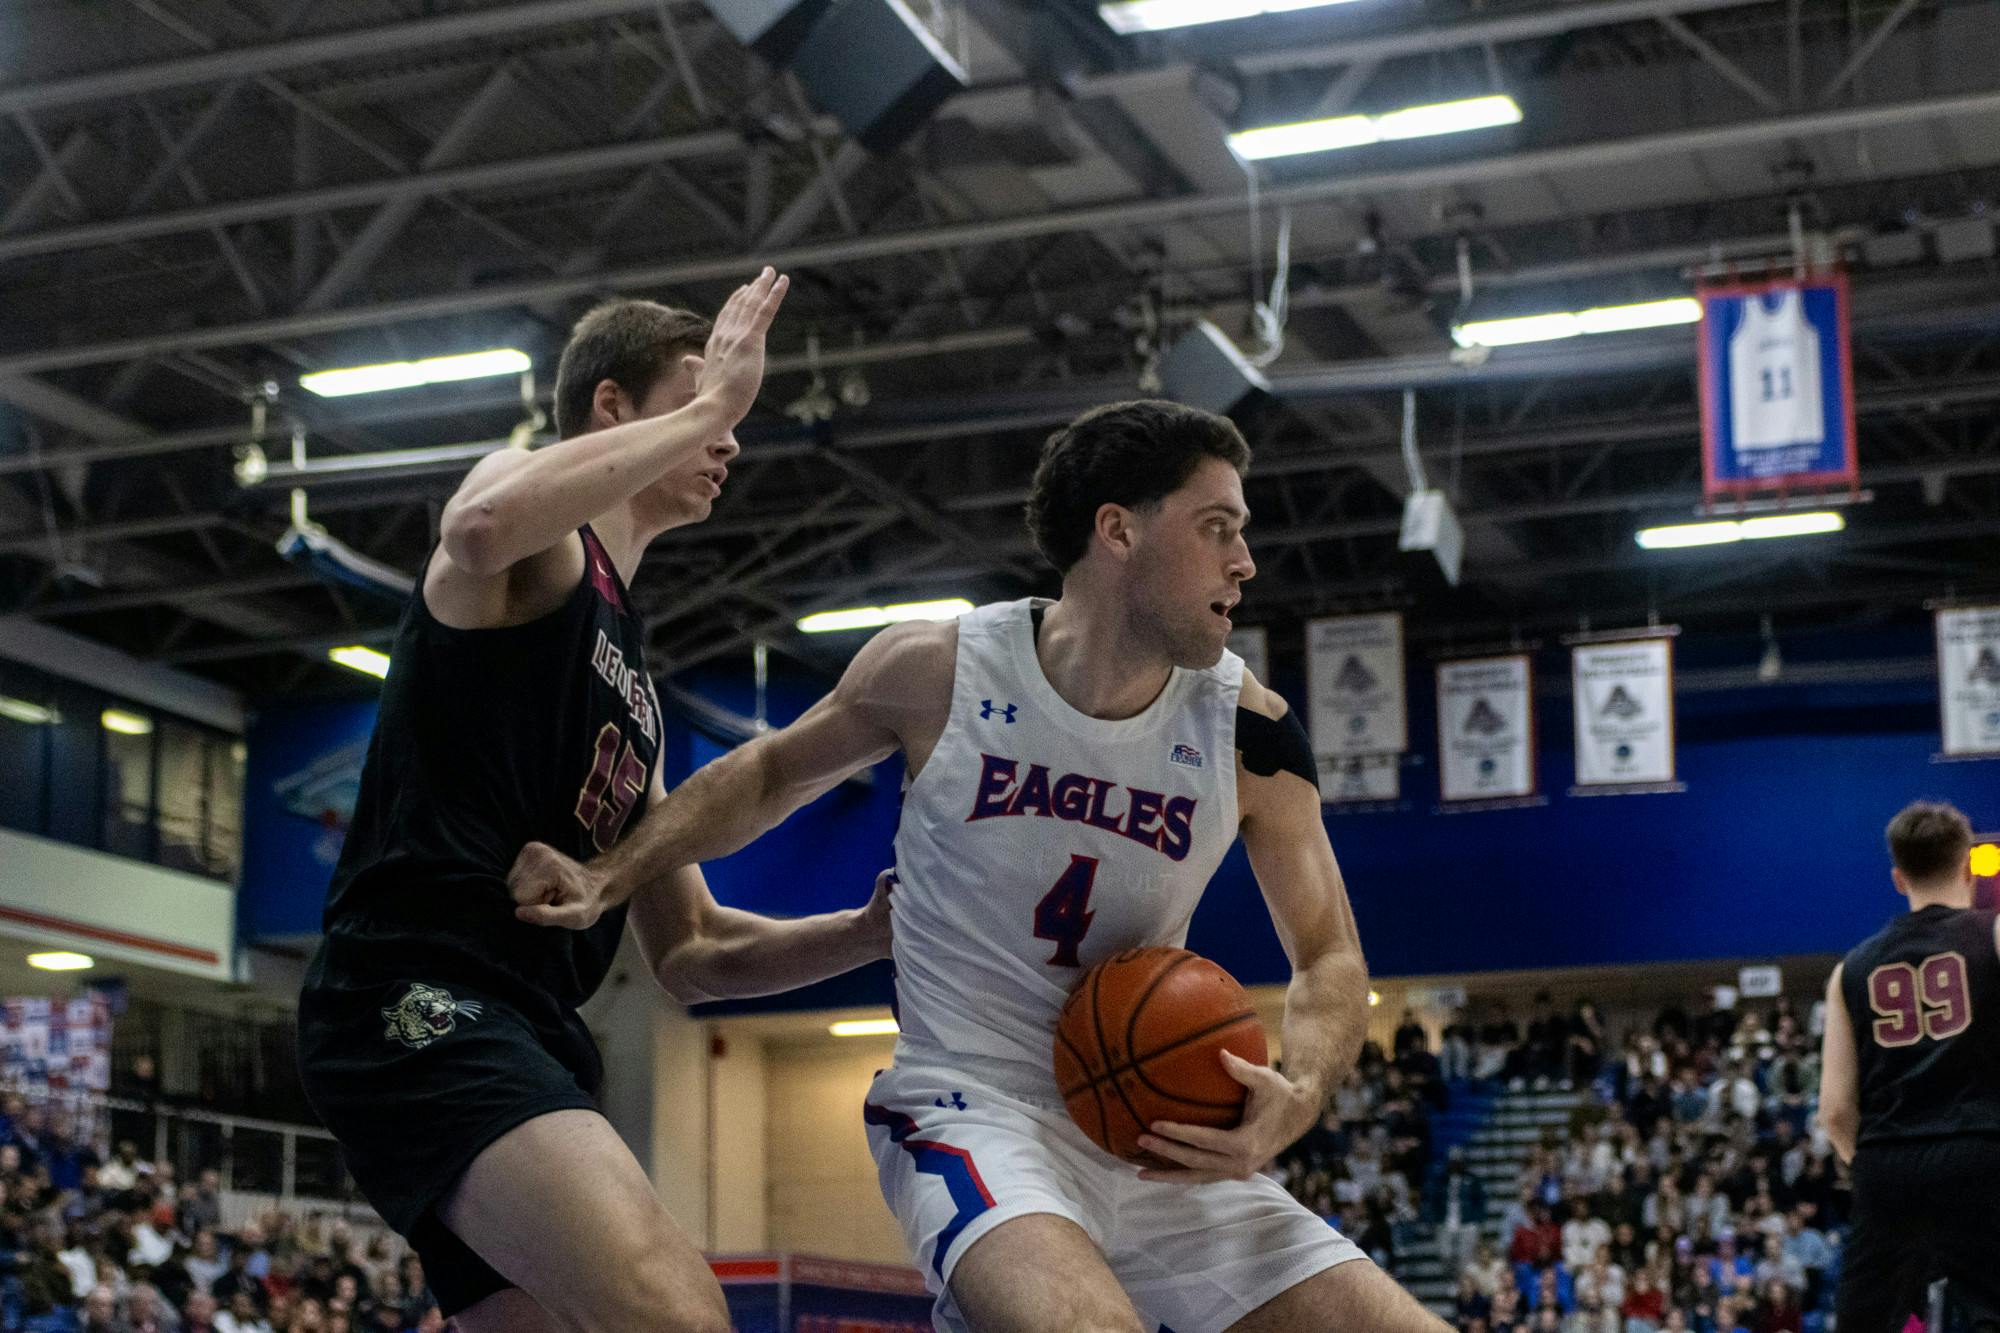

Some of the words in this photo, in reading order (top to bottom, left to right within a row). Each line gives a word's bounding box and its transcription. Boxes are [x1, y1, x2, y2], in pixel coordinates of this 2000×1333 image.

[1761, 366, 1792, 401] 11
[574, 721, 647, 853] 15
[965, 753, 1198, 862] EAGLES
[1033, 853, 1099, 967] 4
[1867, 950, 1972, 1048] 99
